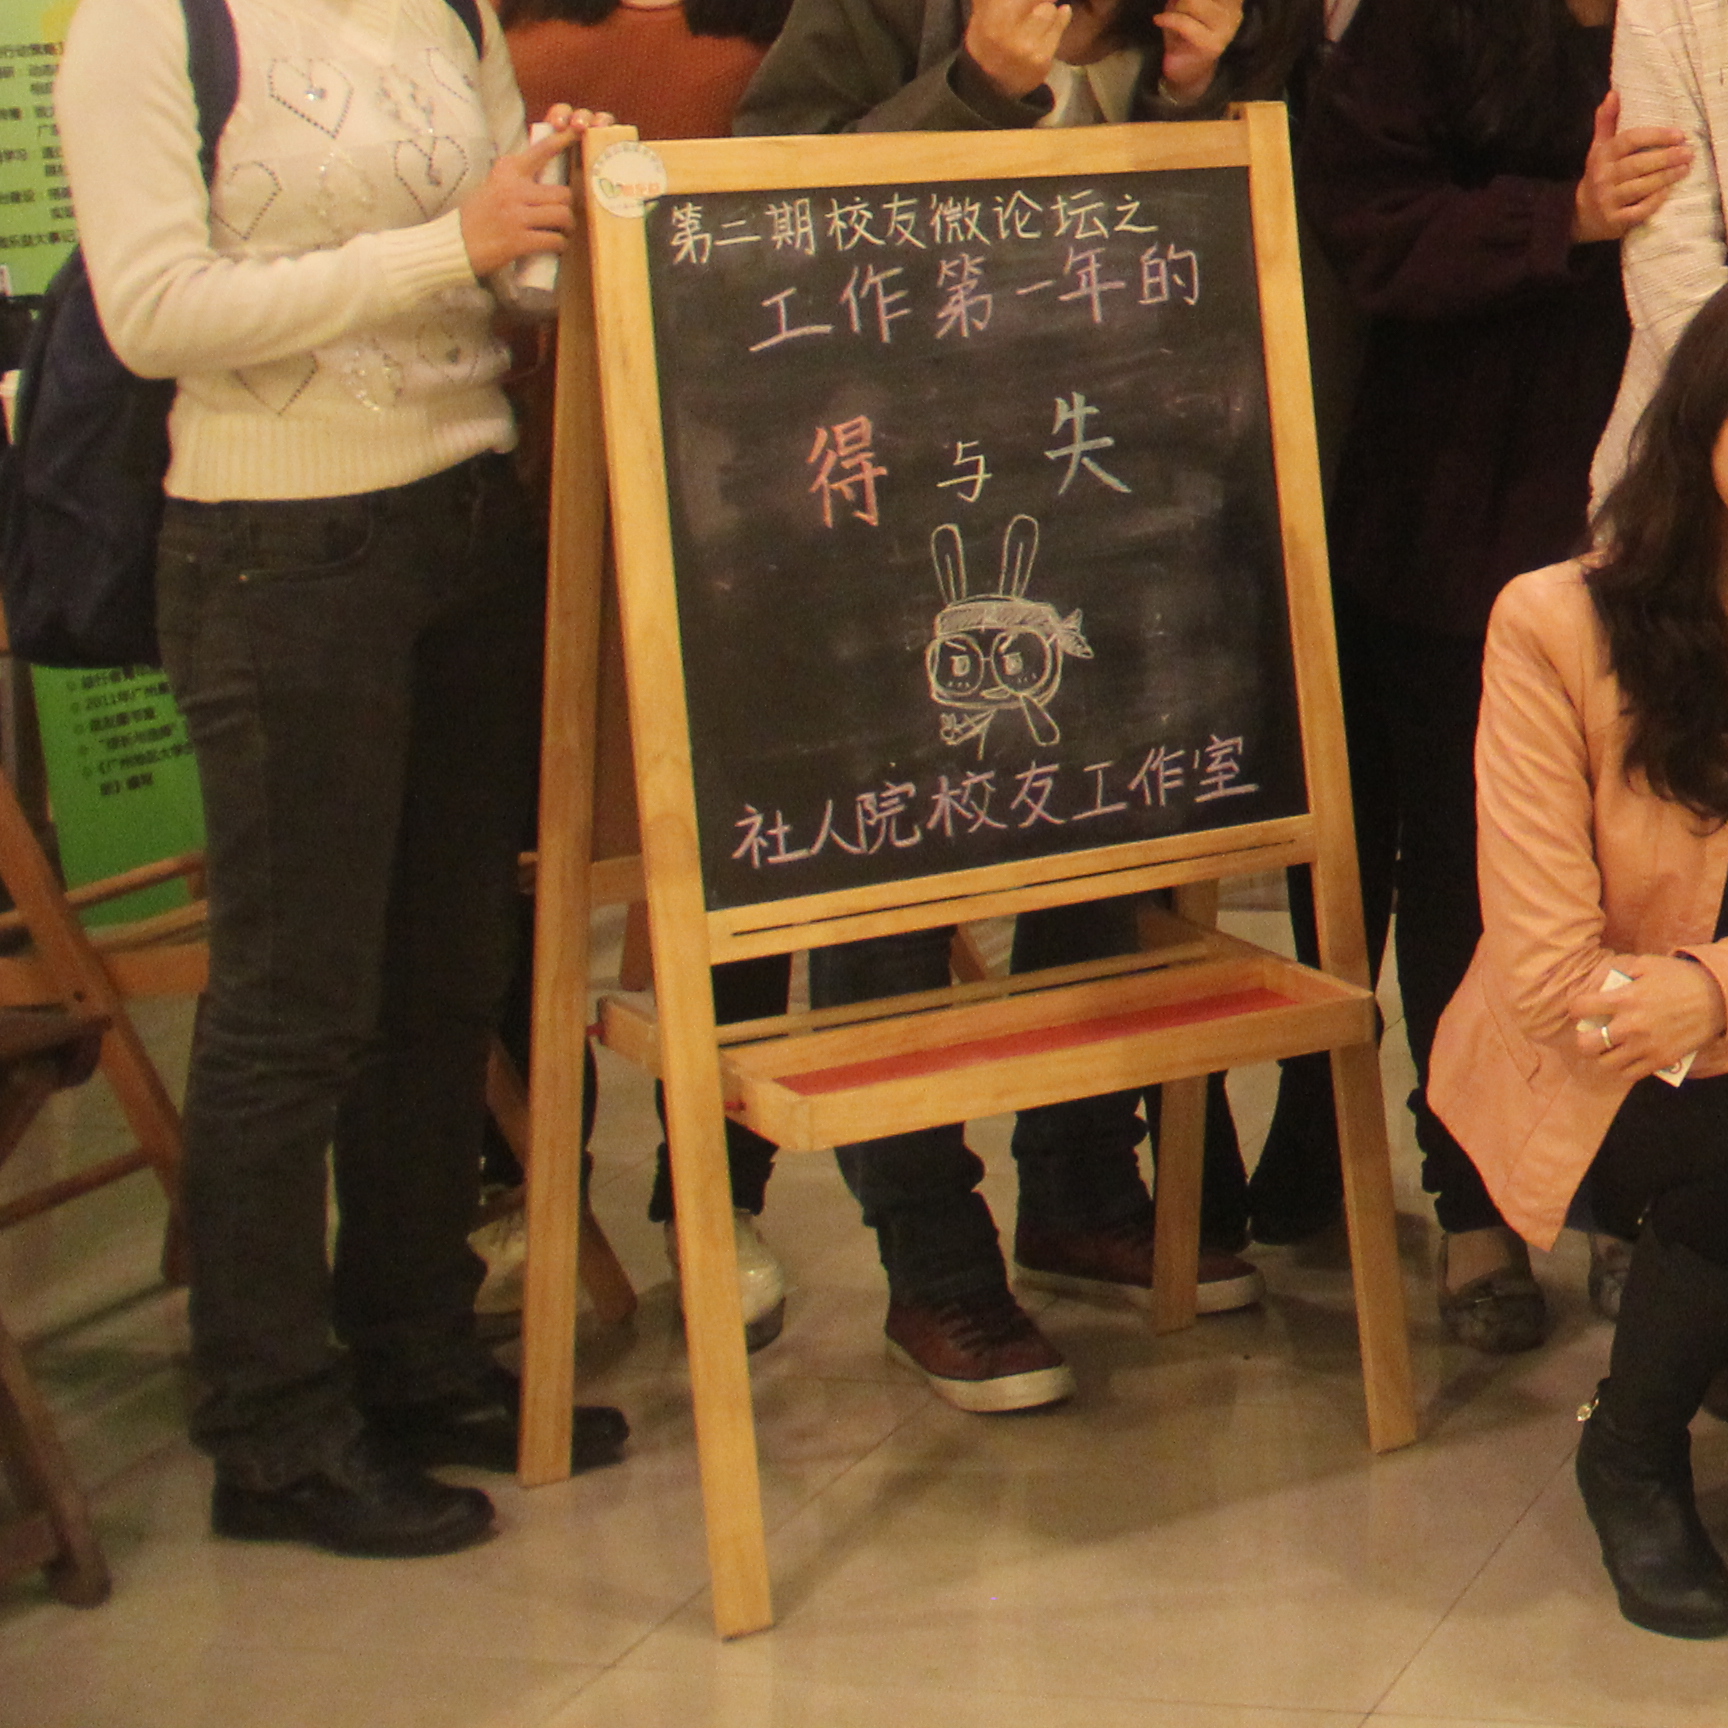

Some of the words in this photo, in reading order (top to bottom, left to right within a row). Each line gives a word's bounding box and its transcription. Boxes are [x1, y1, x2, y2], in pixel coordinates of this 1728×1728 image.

[669, 191, 1158, 267] 第二期校友微论坛之
[749, 241, 1201, 352] 工作第一年的
[732, 735, 1260, 871] 社人院校友工作室
